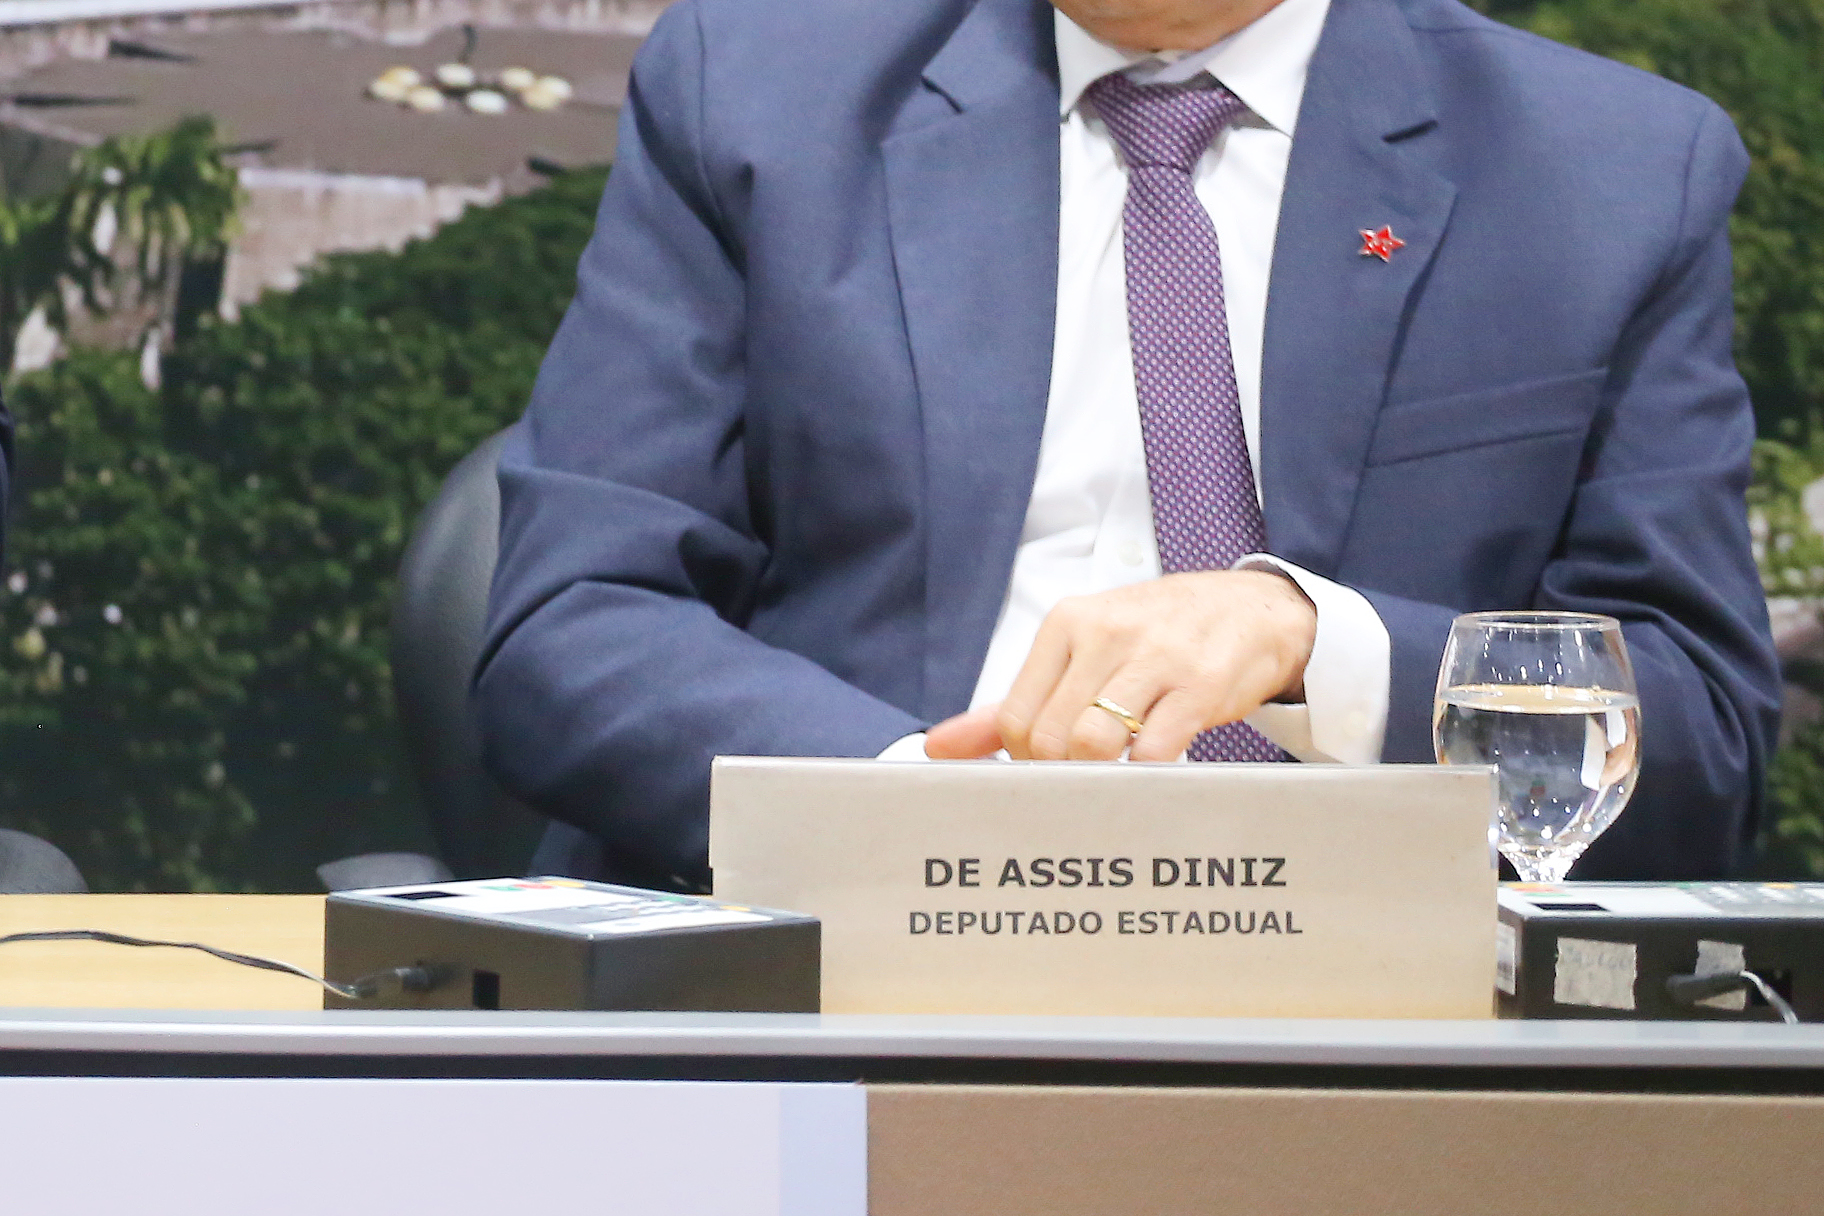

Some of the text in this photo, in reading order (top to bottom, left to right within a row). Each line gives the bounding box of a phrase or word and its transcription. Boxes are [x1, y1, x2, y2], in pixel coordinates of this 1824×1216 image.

[924, 857, 1288, 888] DE ASSIS DINIZ
[908, 910, 1304, 935] DEPUTADO ESTADUAL
